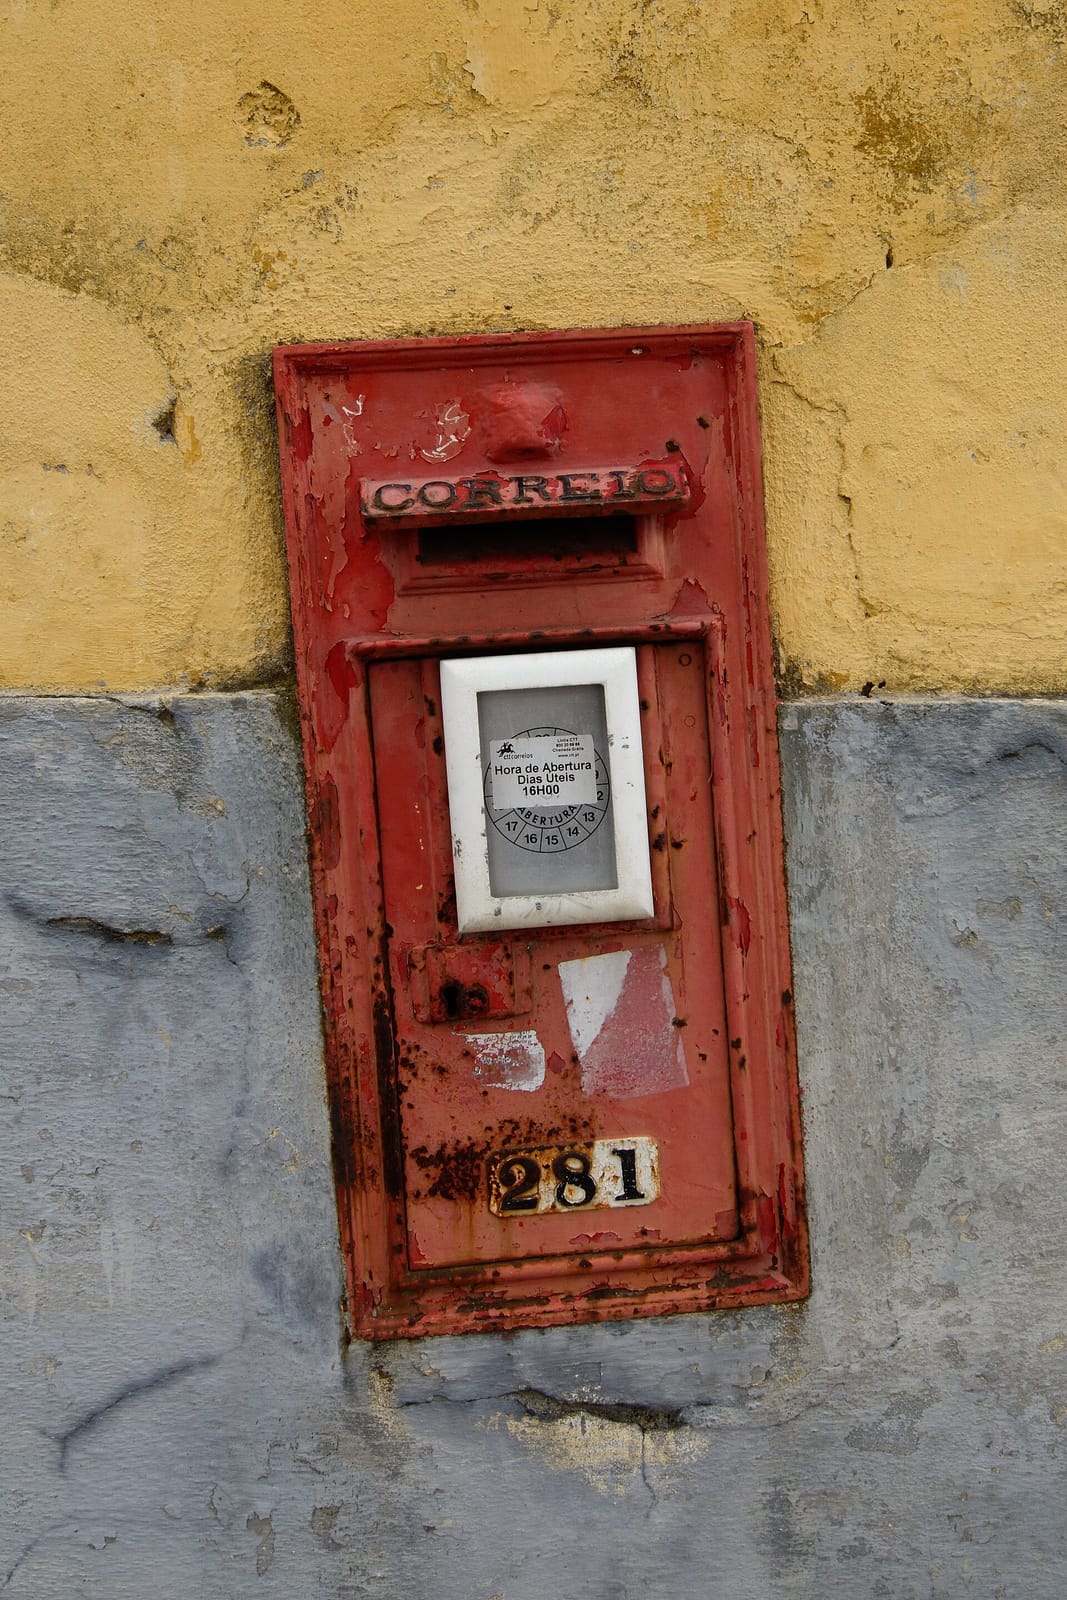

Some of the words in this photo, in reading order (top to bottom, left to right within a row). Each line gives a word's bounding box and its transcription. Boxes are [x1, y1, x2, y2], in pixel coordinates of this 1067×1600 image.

[374, 469, 676, 511] CORREIO
[494, 765, 522, 775] Hora
[525, 763, 539, 773] de
[542, 761, 592, 772] Abertura
[517, 775, 543, 785] Dias
[522, 784, 560, 796] 16H00
[517, 804, 578, 826] ABERTURA
[505, 821, 519, 831] 17
[524, 833, 538, 844] 16
[544, 835, 559, 845] 15
[566, 826, 579, 837] 14
[582, 812, 595, 822] 13
[500, 1149, 645, 1211] 281
